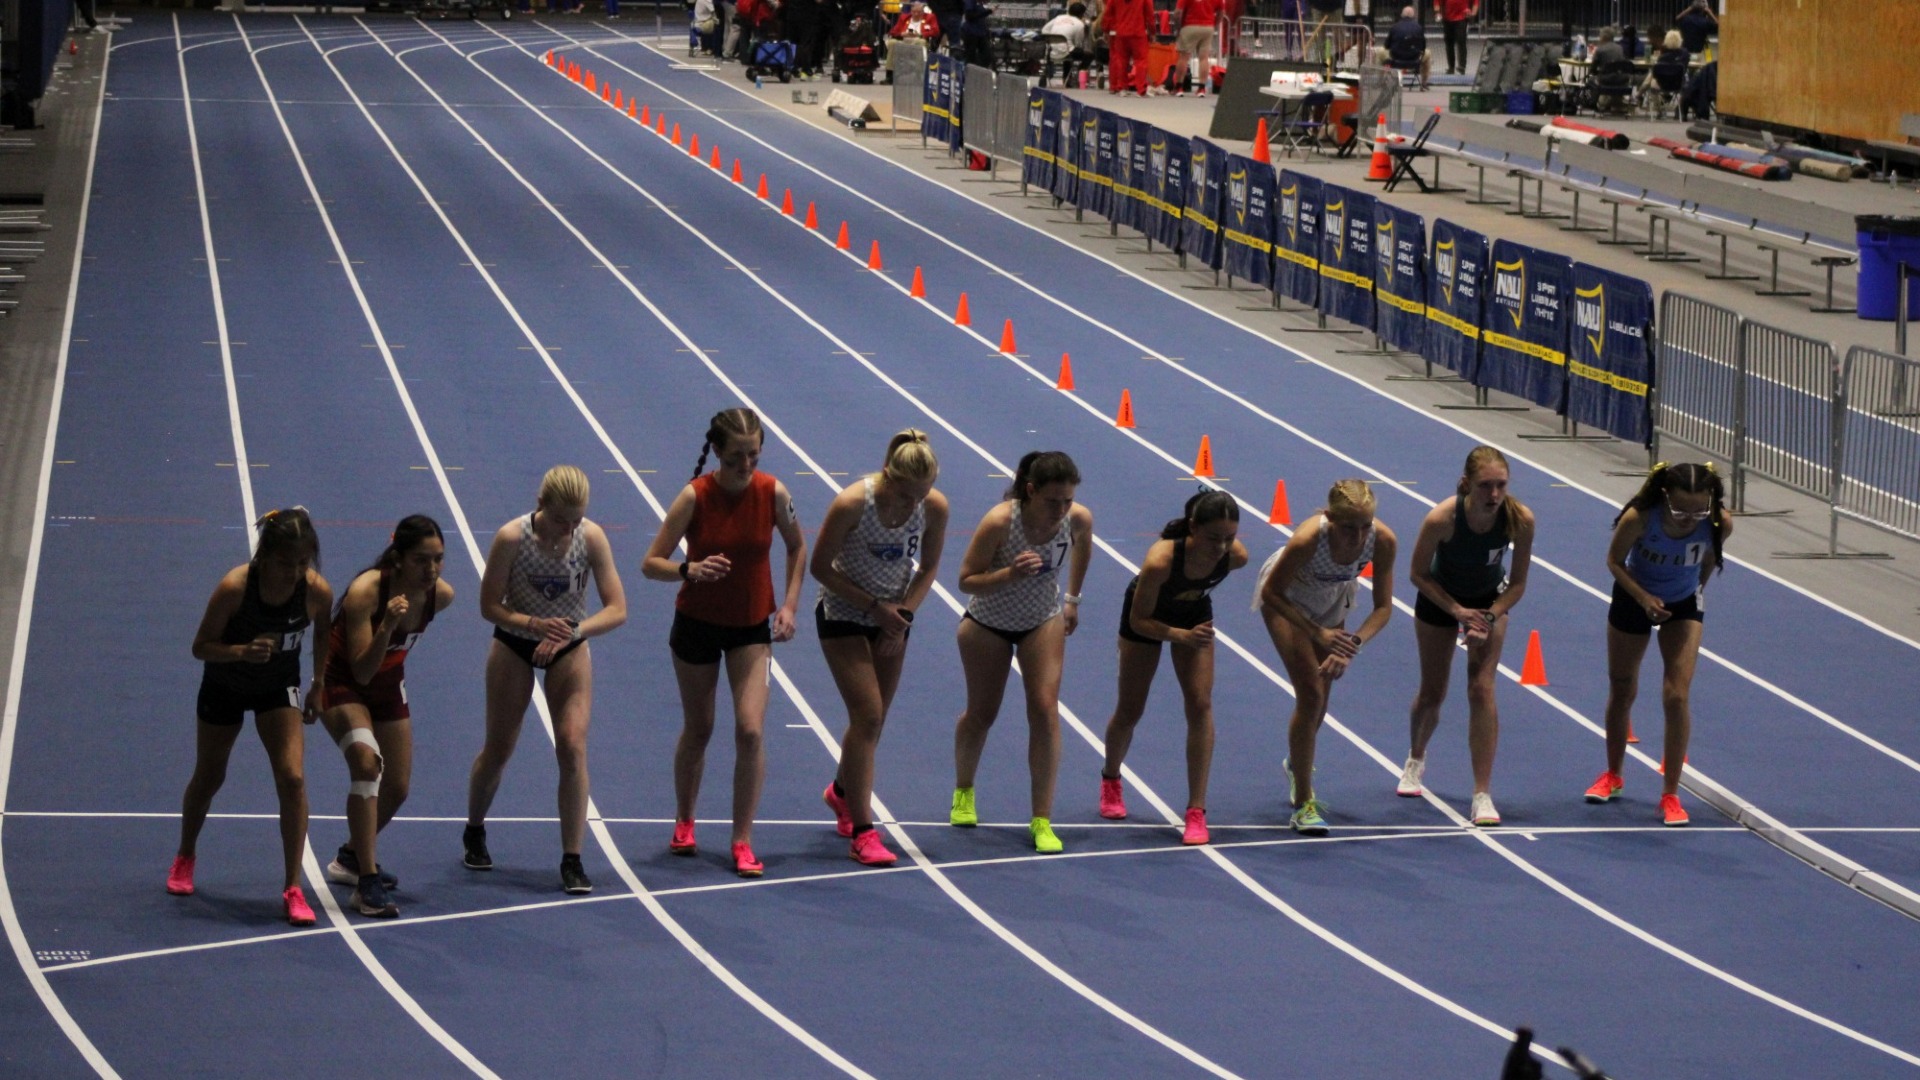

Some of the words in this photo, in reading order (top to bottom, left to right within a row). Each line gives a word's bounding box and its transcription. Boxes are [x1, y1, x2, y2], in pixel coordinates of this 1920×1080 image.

[1496, 273, 1521, 300] NAU
[1577, 300, 1600, 331] NAU
[907, 535, 919, 557] 8
[1056, 542, 1068, 567] 7
[1691, 544, 1700, 564] 1
[575, 569, 588, 591] 10
